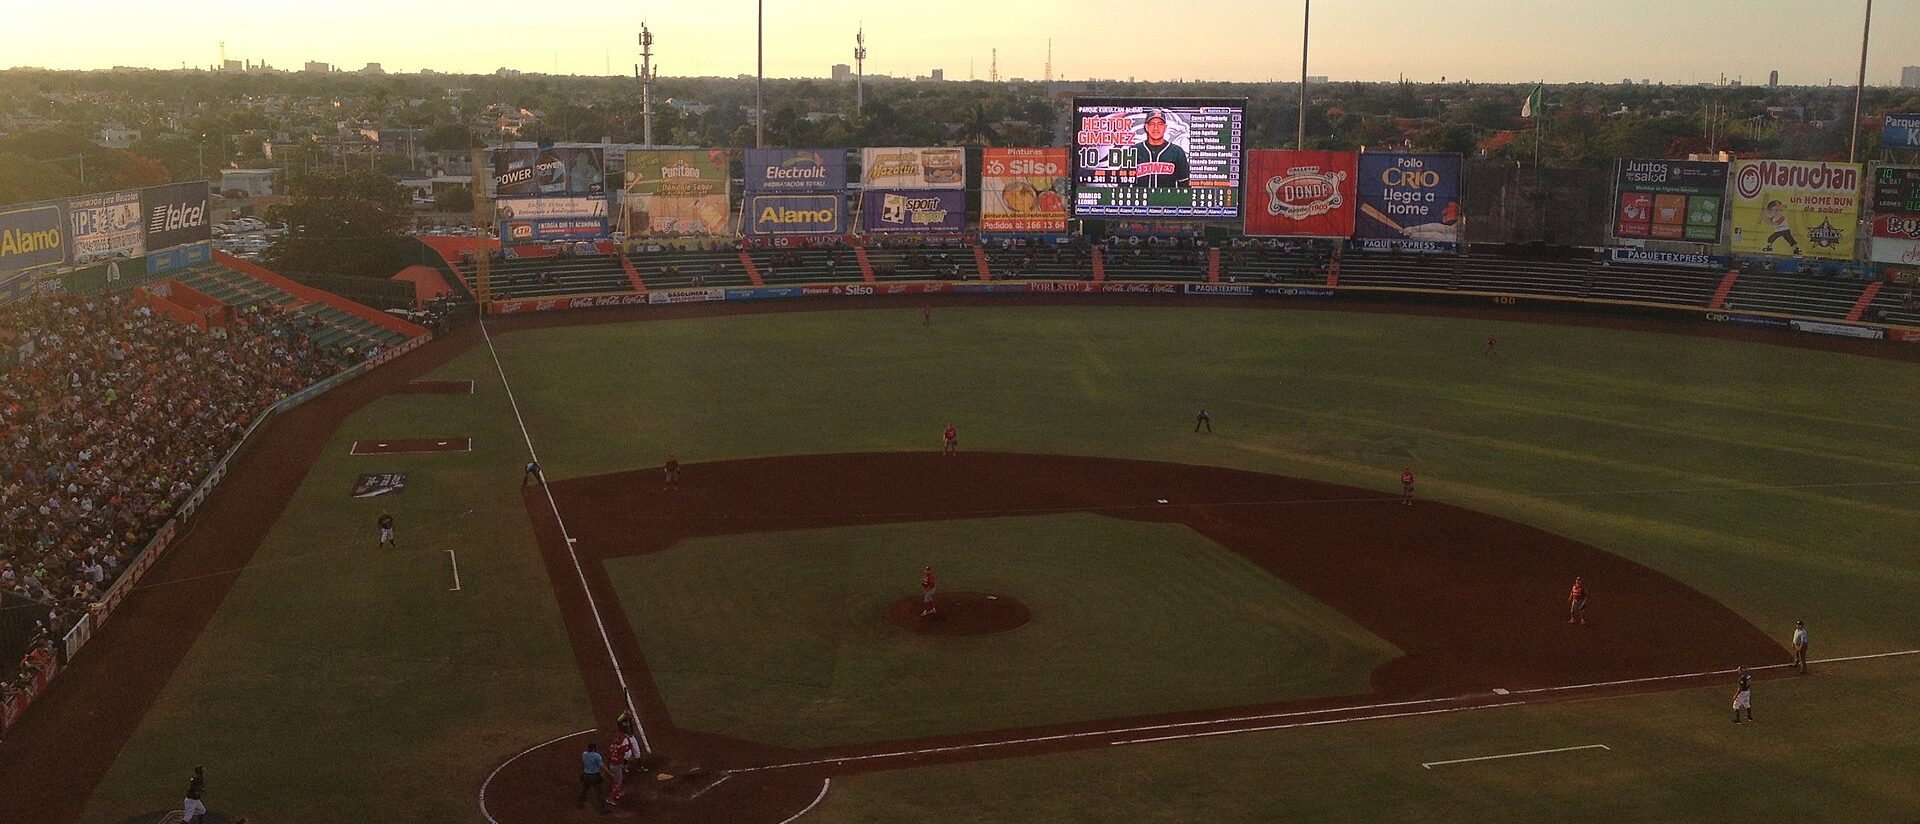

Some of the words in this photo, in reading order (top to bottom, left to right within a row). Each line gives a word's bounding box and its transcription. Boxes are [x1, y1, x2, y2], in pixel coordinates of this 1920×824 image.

[1082, 115, 1133, 131] HÉCTOR
[1885, 116, 1920, 130] Parque
[1078, 131, 1137, 145] GIMENEZ
[1079, 147, 1099, 168] 10
[1108, 147, 1137, 168] DH
[1398, 158, 1423, 168] Pollo
[767, 166, 826, 179] Electrolit
[1010, 160, 1057, 174] Silso
[1626, 161, 1668, 173] Juntos
[496, 168, 532, 184] POWER
[1634, 171, 1667, 183] salud
[1759, 161, 1857, 190] Maruchan
[1384, 188, 1421, 204] Llega
[1425, 192, 1434, 202] a
[1790, 196, 1802, 204] un
[1805, 196, 1831, 206] HOME
[1833, 197, 1853, 206] RUN
[906, 197, 940, 211] sport
[1388, 202, 1429, 215] home
[165, 200, 206, 231] telcel
[759, 206, 832, 223] Alamo
[1, 228, 60, 257] Alamo
[1628, 251, 1709, 263] PAQUETEXPRESS
[846, 285, 874, 295] Silso
[1195, 285, 1250, 293] PAQUETEXPRESS
